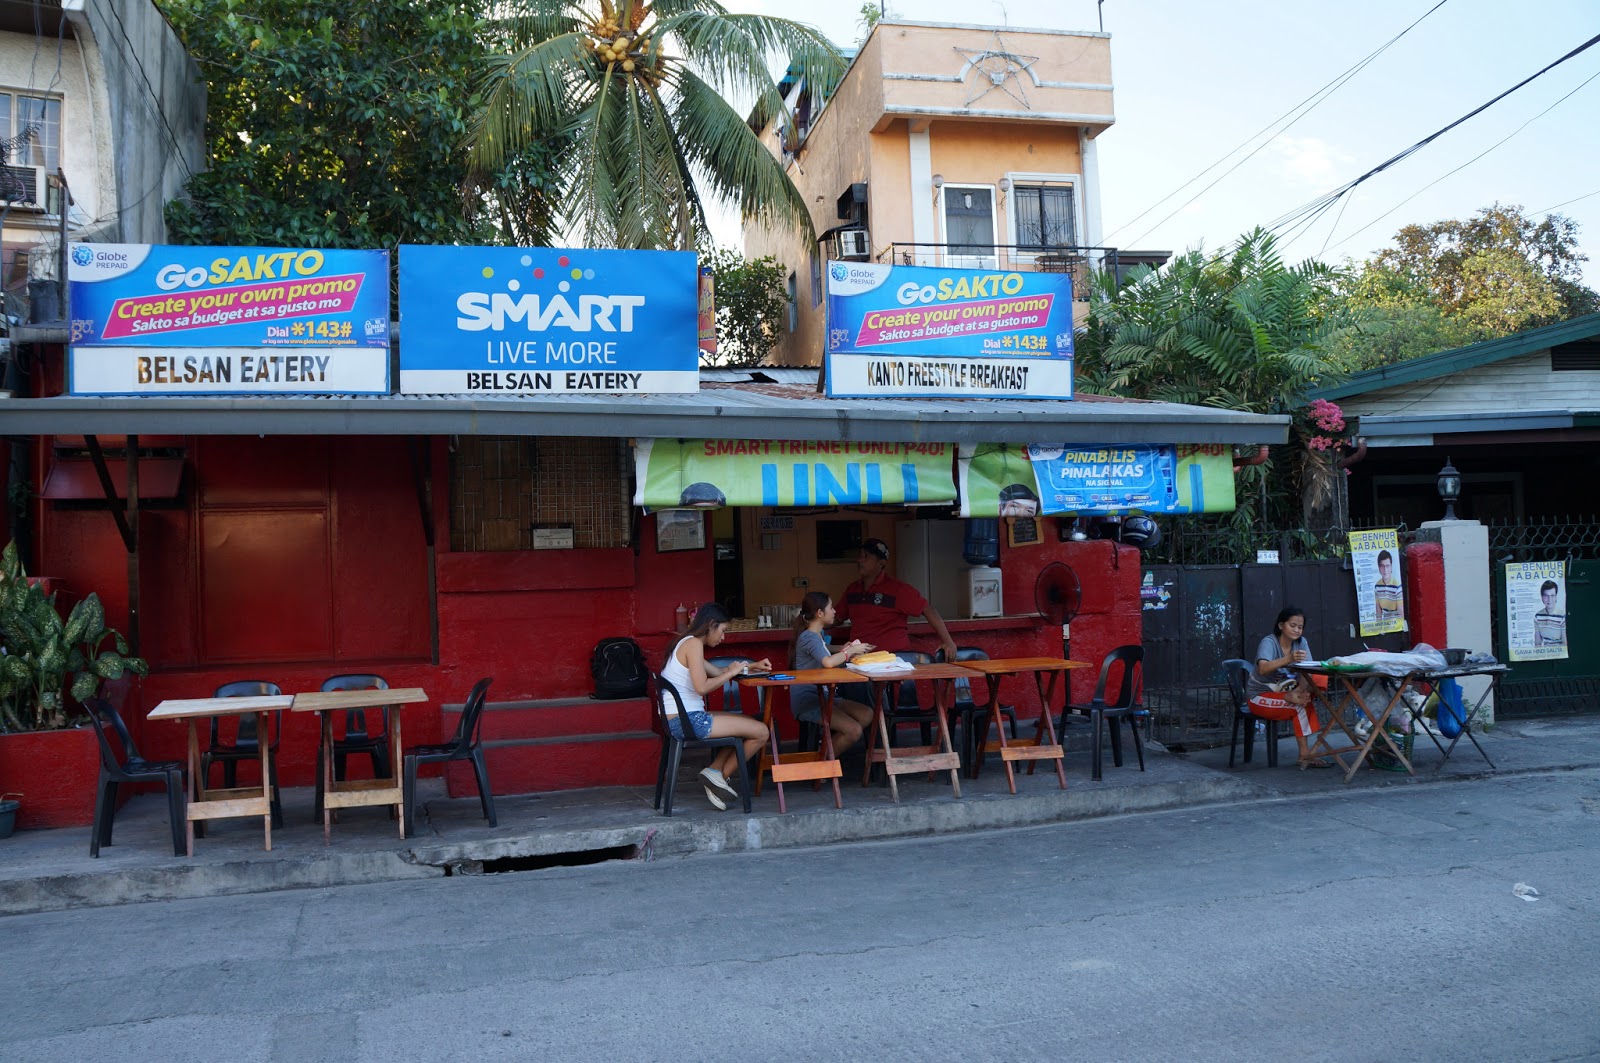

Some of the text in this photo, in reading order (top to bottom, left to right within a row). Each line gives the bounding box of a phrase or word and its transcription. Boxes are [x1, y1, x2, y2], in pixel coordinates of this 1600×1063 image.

[97, 252, 127, 261] Globe
[156, 250, 324, 290] GoSAKTO
[850, 268, 874, 278] Globe
[896, 273, 1024, 305] GoSAKTO
[118, 278, 356, 319] Create your own promo
[131, 297, 342, 332] Sakto sa budget at sa gusto mo
[456, 292, 646, 332] SMART
[867, 298, 1049, 330] Create your own promo
[267, 326, 289, 337] Dial
[878, 314, 1038, 342] Sakto sa budget at sa gusto mo
[984, 338, 1001, 348] Dial
[487, 341, 618, 364] LIVE MORE
[138, 355, 330, 384] BELSAN EATERY
[867, 362, 1029, 390] KANTO FREESTYLE BREAKFAST
[467, 372, 643, 390] BELSAN EATERY
[704, 439, 772, 456] SMART
[777, 440, 850, 455] TRI-NET
[857, 440, 900, 455] UNLI
[1064, 450, 1136, 464] PINABILIS
[1060, 464, 1144, 479] PINALAKAS
[1358, 540, 1396, 550] ABALOS
[1362, 531, 1396, 542] BENHUR
[1516, 570, 1564, 580] ABALOS
[1522, 561, 1563, 572] BENHUR
